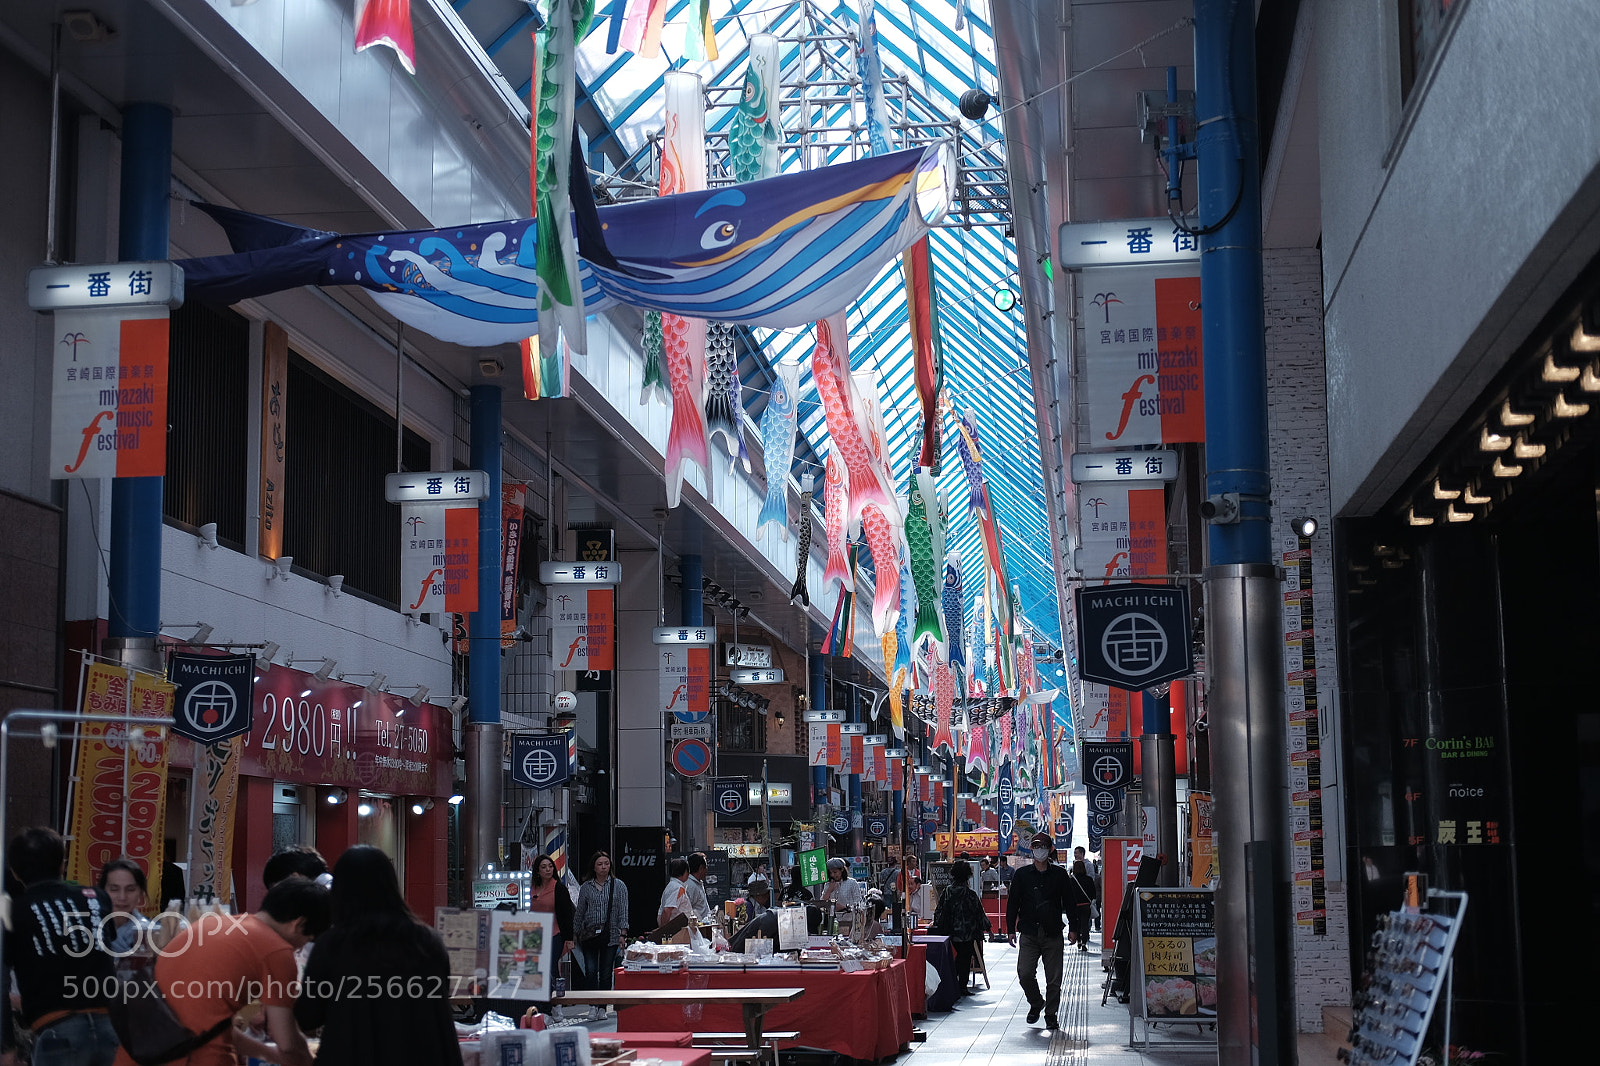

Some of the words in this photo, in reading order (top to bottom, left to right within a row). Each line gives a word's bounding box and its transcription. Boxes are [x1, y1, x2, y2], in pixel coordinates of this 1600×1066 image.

[1081, 227, 1199, 254] 一番街
[46, 270, 153, 298] 一番街
[1100, 326, 1196, 345] 宮崎国際音楽祭
[1138, 345, 1198, 374] miyazaki
[67, 365, 154, 382] 宮崎国際音楽祭
[1157, 372, 1199, 393] music
[99, 382, 154, 410] miyazaki
[115, 408, 153, 428] music
[1085, 456, 1163, 476] 一番街
[398, 476, 471, 495] 一番街
[1116, 532, 1157, 551] miyazaki
[432, 551, 469, 568] miyazaki
[1129, 550, 1157, 565] music
[444, 568, 469, 580] music
[554, 565, 608, 580] 一番街
[1091, 597, 1139, 610] MACHI
[1144, 596, 1174, 608] ICHI
[660, 629, 706, 641] 一番街
[181, 663, 221, 675] MACHI
[224, 664, 247, 674] ICHI
[737, 671, 775, 681] 一番街
[375, 719, 392, 748] Tel.
[394, 723, 428, 754] 27-5050
[518, 739, 545, 747] MACHI
[1403, 738, 1420, 748] 7F
[1425, 735, 1472, 749] Corin's
[1405, 792, 1422, 801] 6F
[1449, 787, 1484, 798] noice
[1408, 835, 1425, 845] 5F
[1437, 820, 1483, 845] 炭王
[621, 855, 657, 867] OLIVE
[1147, 940, 1187, 949] うるるの
[1151, 951, 1183, 961] 肉寿司
[1147, 962, 1189, 973] 食べ放題
